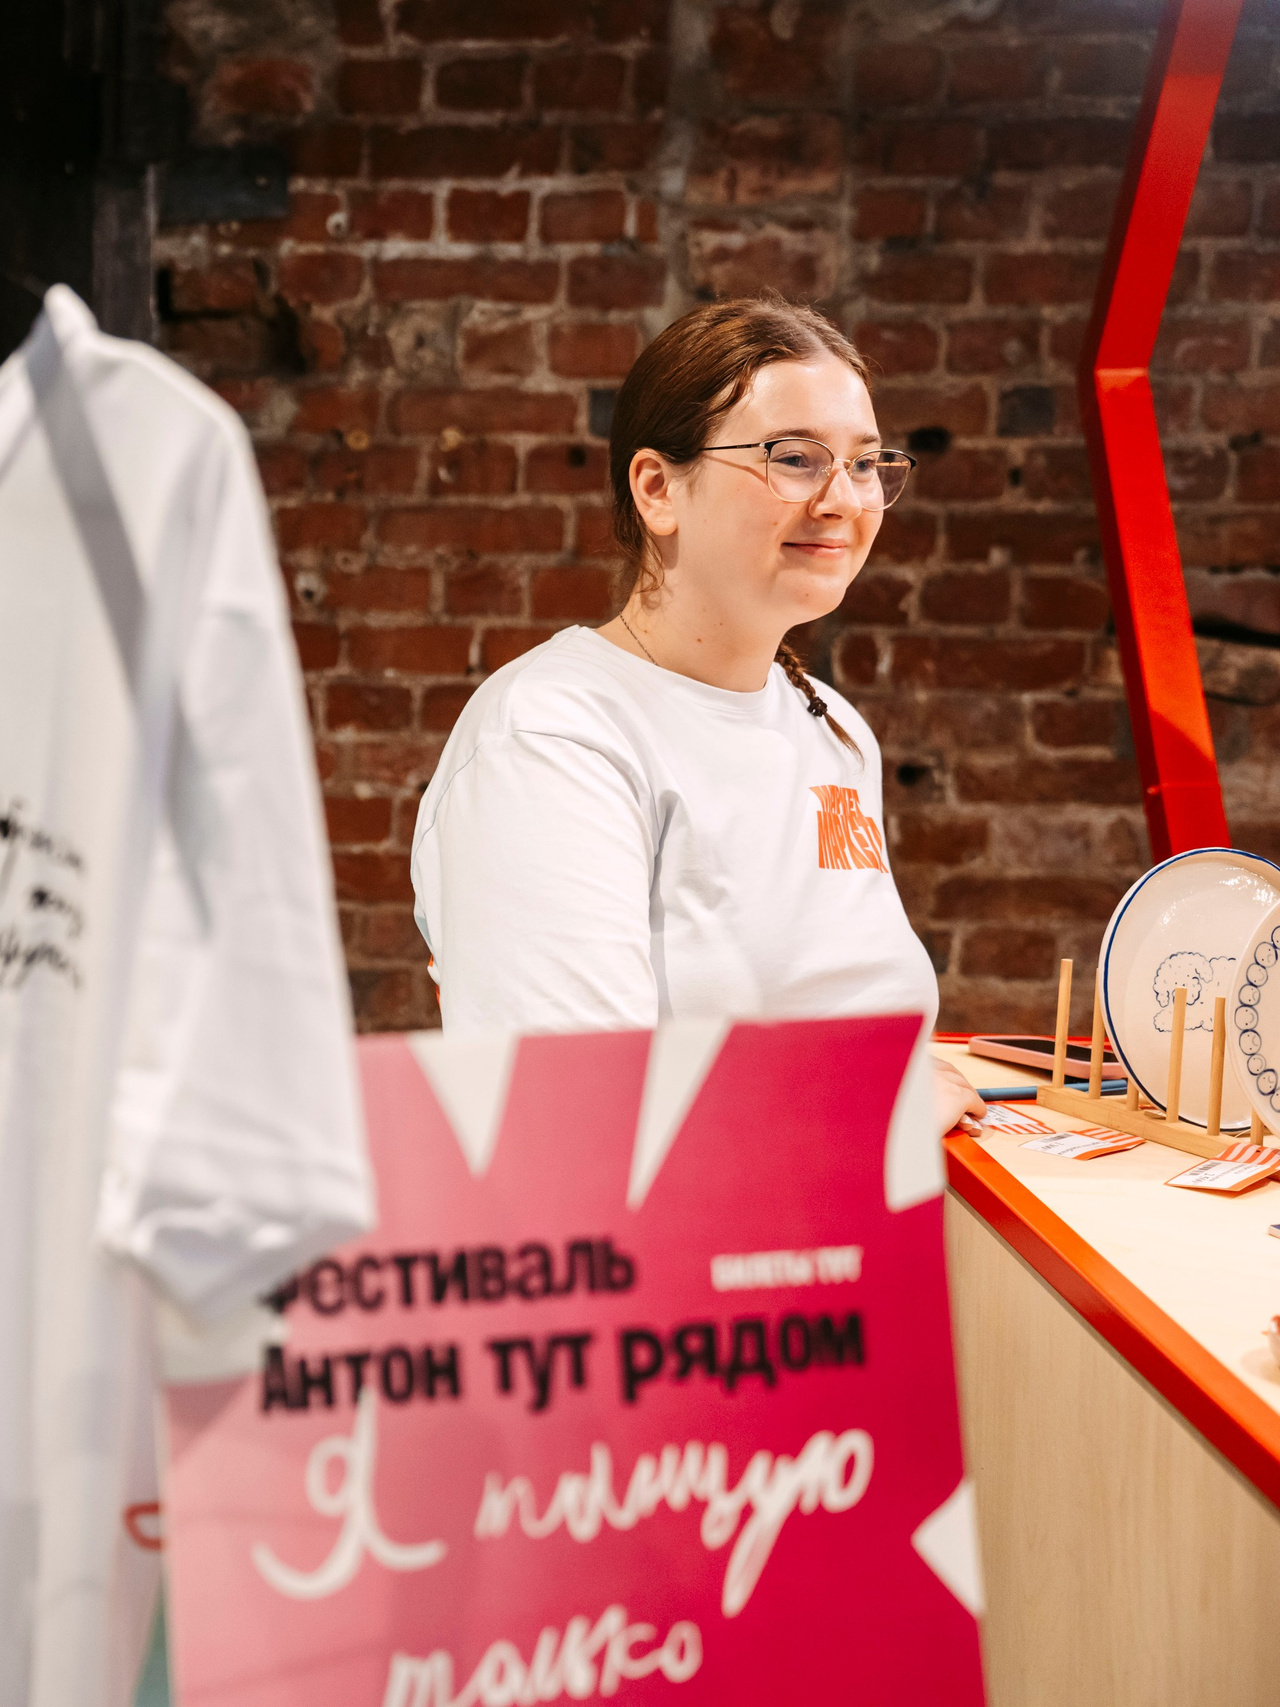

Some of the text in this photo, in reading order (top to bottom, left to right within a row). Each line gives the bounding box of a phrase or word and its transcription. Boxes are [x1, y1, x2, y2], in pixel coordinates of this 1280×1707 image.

[261, 1311, 867, 1416] Антон тут рядом
[251, 1390, 448, 1598] Я
